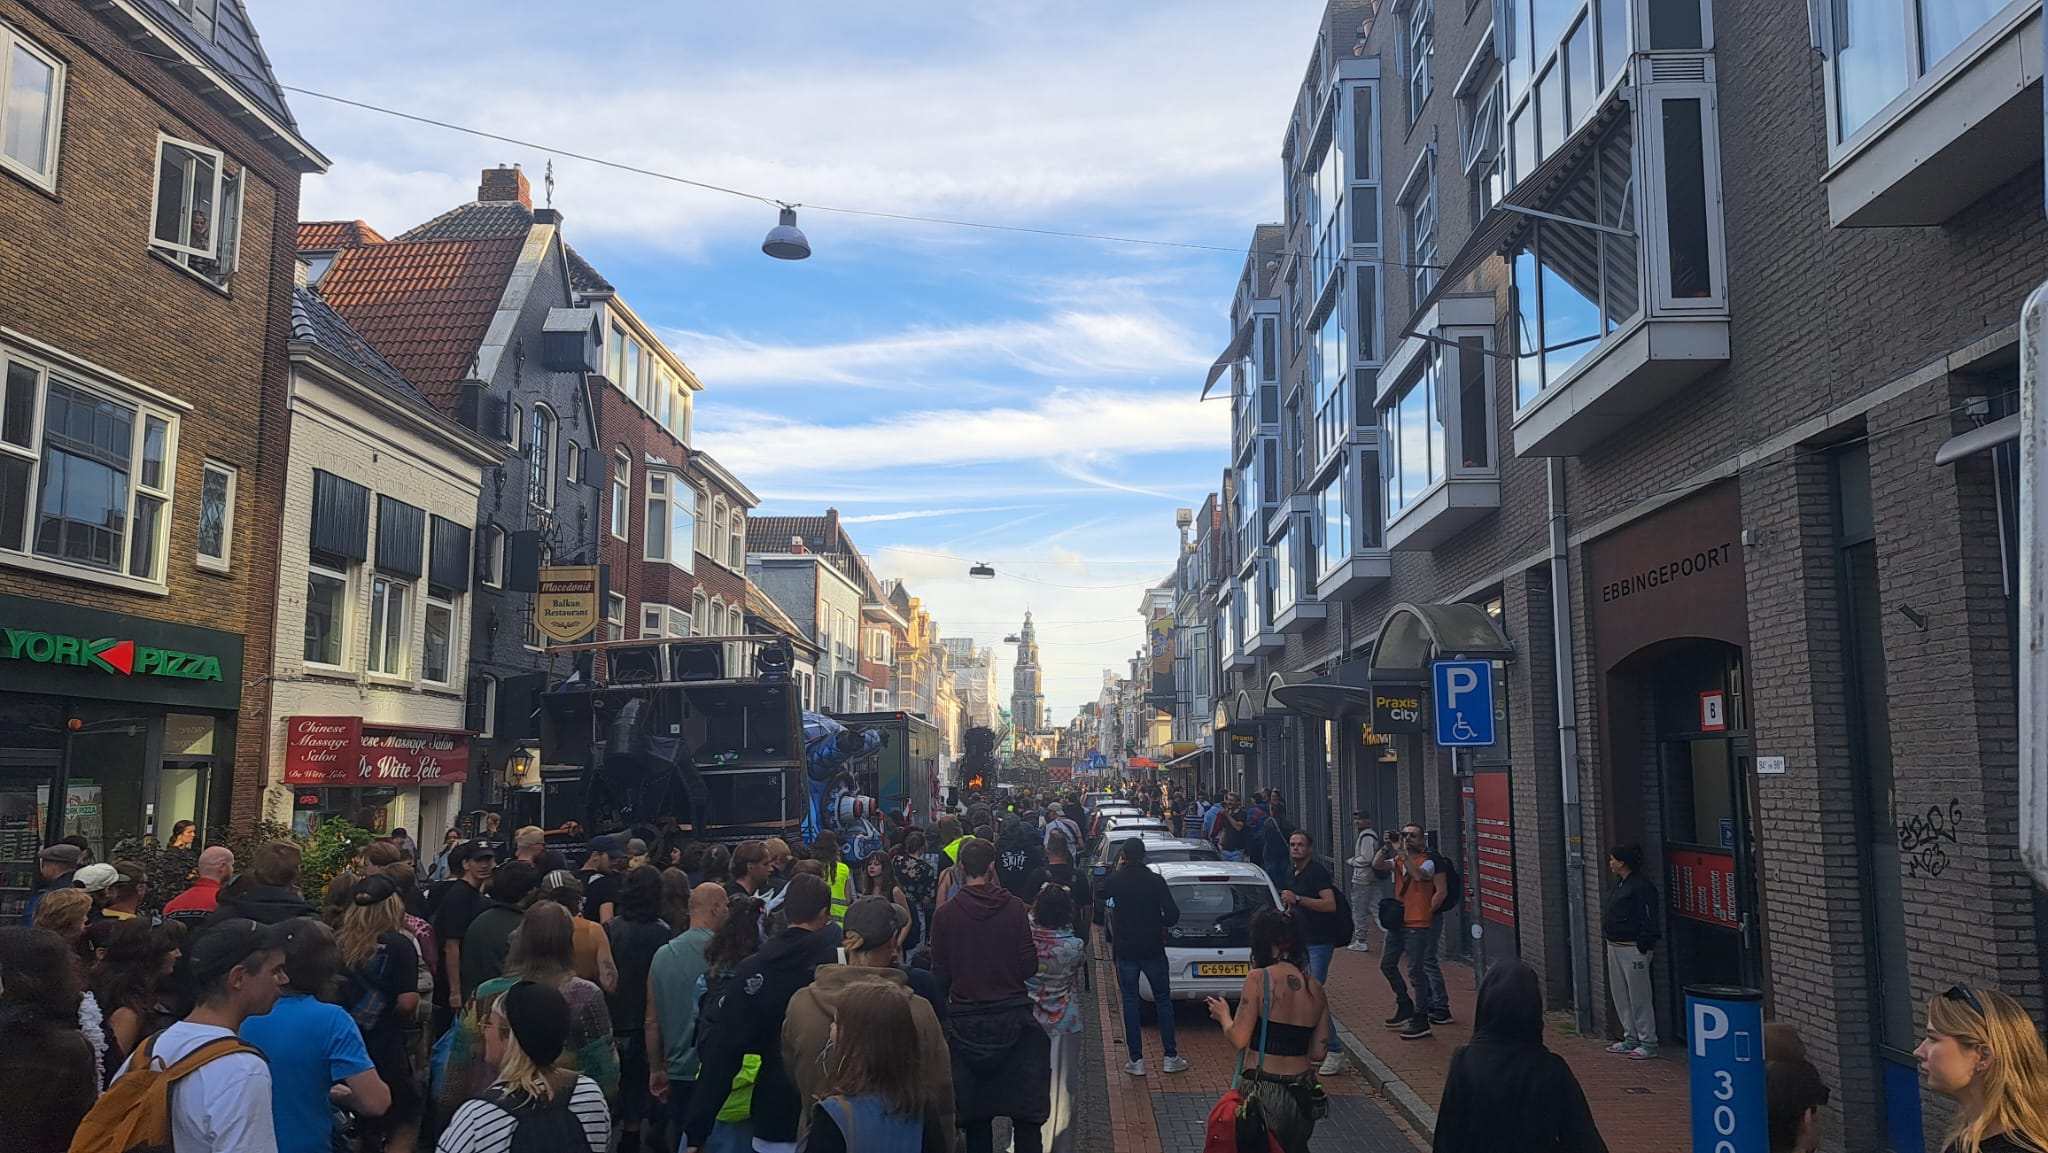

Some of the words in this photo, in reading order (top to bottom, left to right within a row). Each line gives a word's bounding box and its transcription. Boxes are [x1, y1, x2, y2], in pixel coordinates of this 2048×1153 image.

[1602, 543, 1731, 603] EBBINGEPOORT
[552, 599, 581, 608] Balkan
[544, 608, 588, 617] Restaurant
[5, 628, 119, 675] YORK
[135, 646, 224, 682] PIZZA
[1446, 667, 1478, 709] P
[1376, 697, 1418, 709] Praxis
[1709, 702, 1716, 719] B
[1390, 708, 1418, 723] City
[298, 720, 347, 733] Chinese
[291, 734, 350, 751] Massage
[361, 735, 380, 748] ese
[381, 735, 427, 756] Massage
[428, 734, 455, 751] Salon
[301, 749, 337, 762] Salon
[288, 769, 302, 779] De
[359, 754, 373, 779] De
[377, 755, 412, 779] Witte
[412, 756, 441, 783] Lelie
[1201, 964, 1246, 975] G-696-FT
[1693, 1002, 1730, 1057] P
